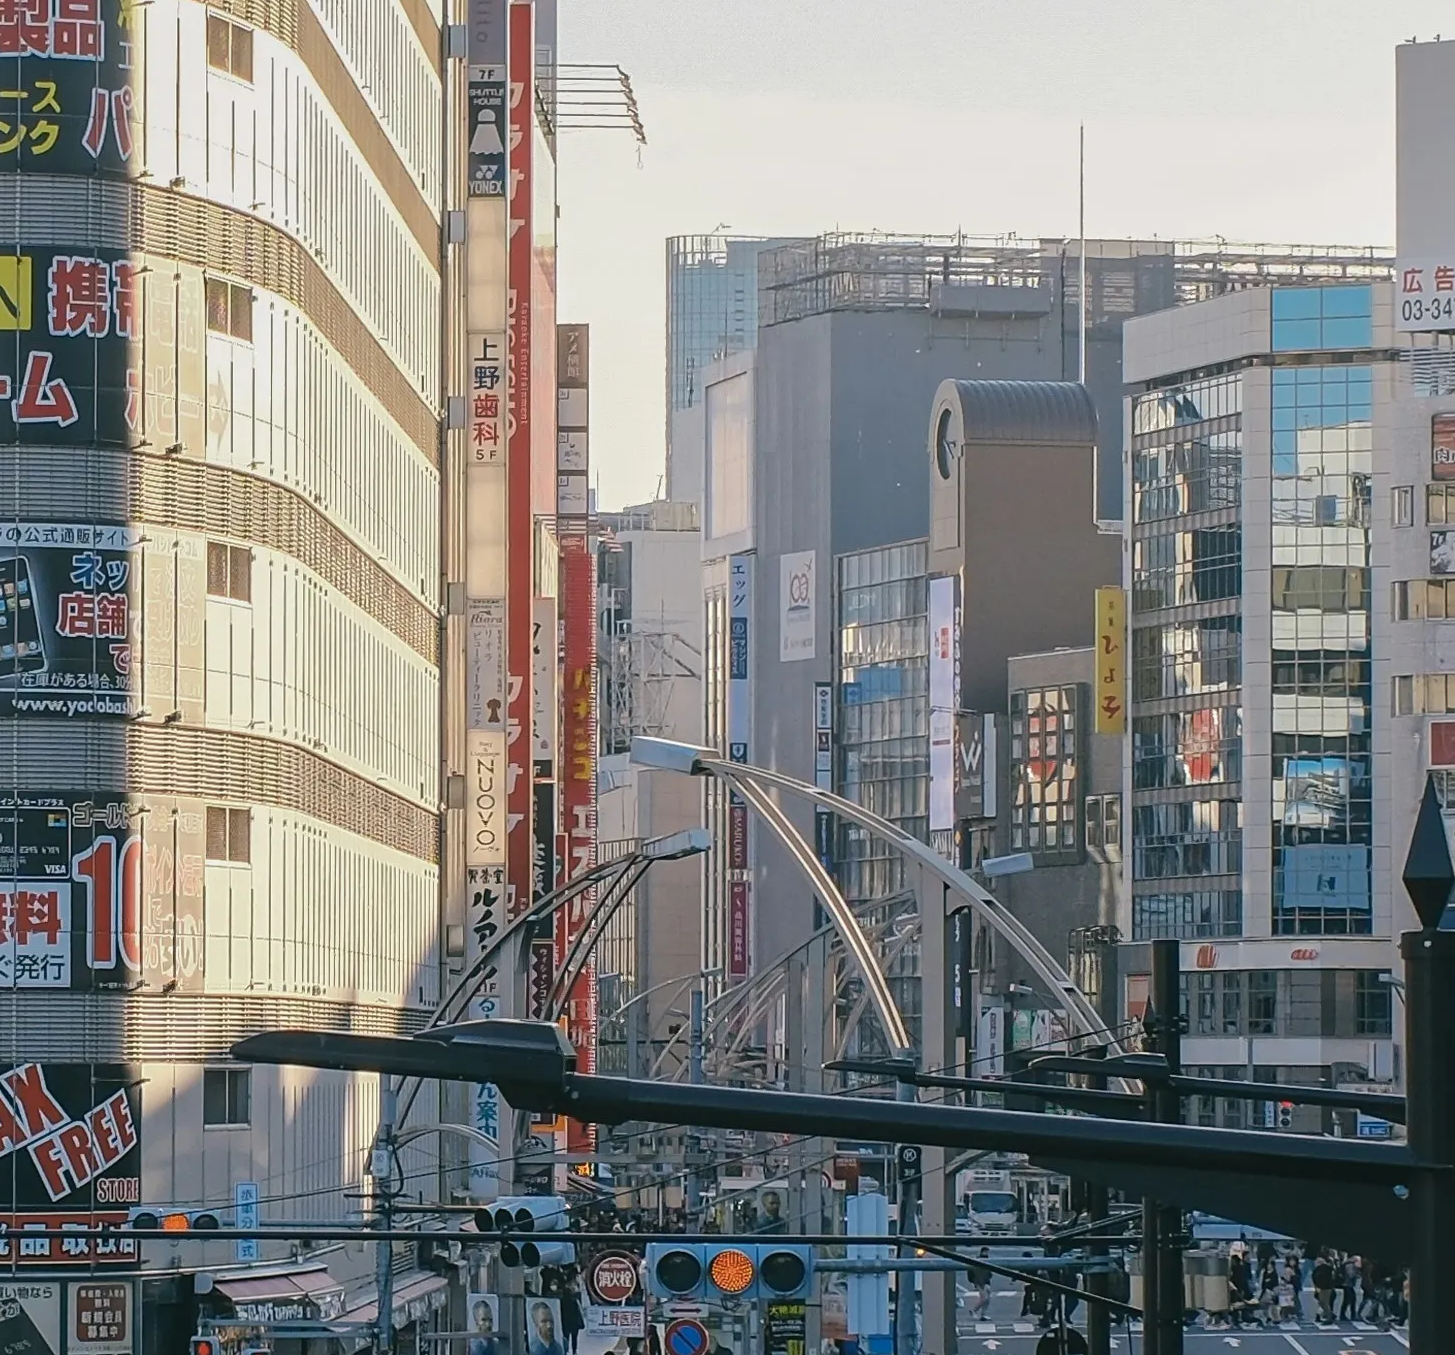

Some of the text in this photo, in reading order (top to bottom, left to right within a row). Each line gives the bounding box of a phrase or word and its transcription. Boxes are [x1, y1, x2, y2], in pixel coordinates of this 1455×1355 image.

[479, 69, 495, 80] 7F
[473, 98, 501, 106] HOUSE
[469, 180, 503, 194] YONEX
[473, 338, 500, 446] 上野歯科
[55, 591, 130, 638] 店舗
[1101, 633, 1121, 720] ひよ子
[476, 759, 496, 847] NUOVO
[44, 864, 67, 875] VISA
[27, 1087, 137, 1203] FREE
[97, 1177, 140, 1203] STORE
[240, 1188, 255, 1259] 歩車分式
[598, 1270, 632, 1289] 消火栓
